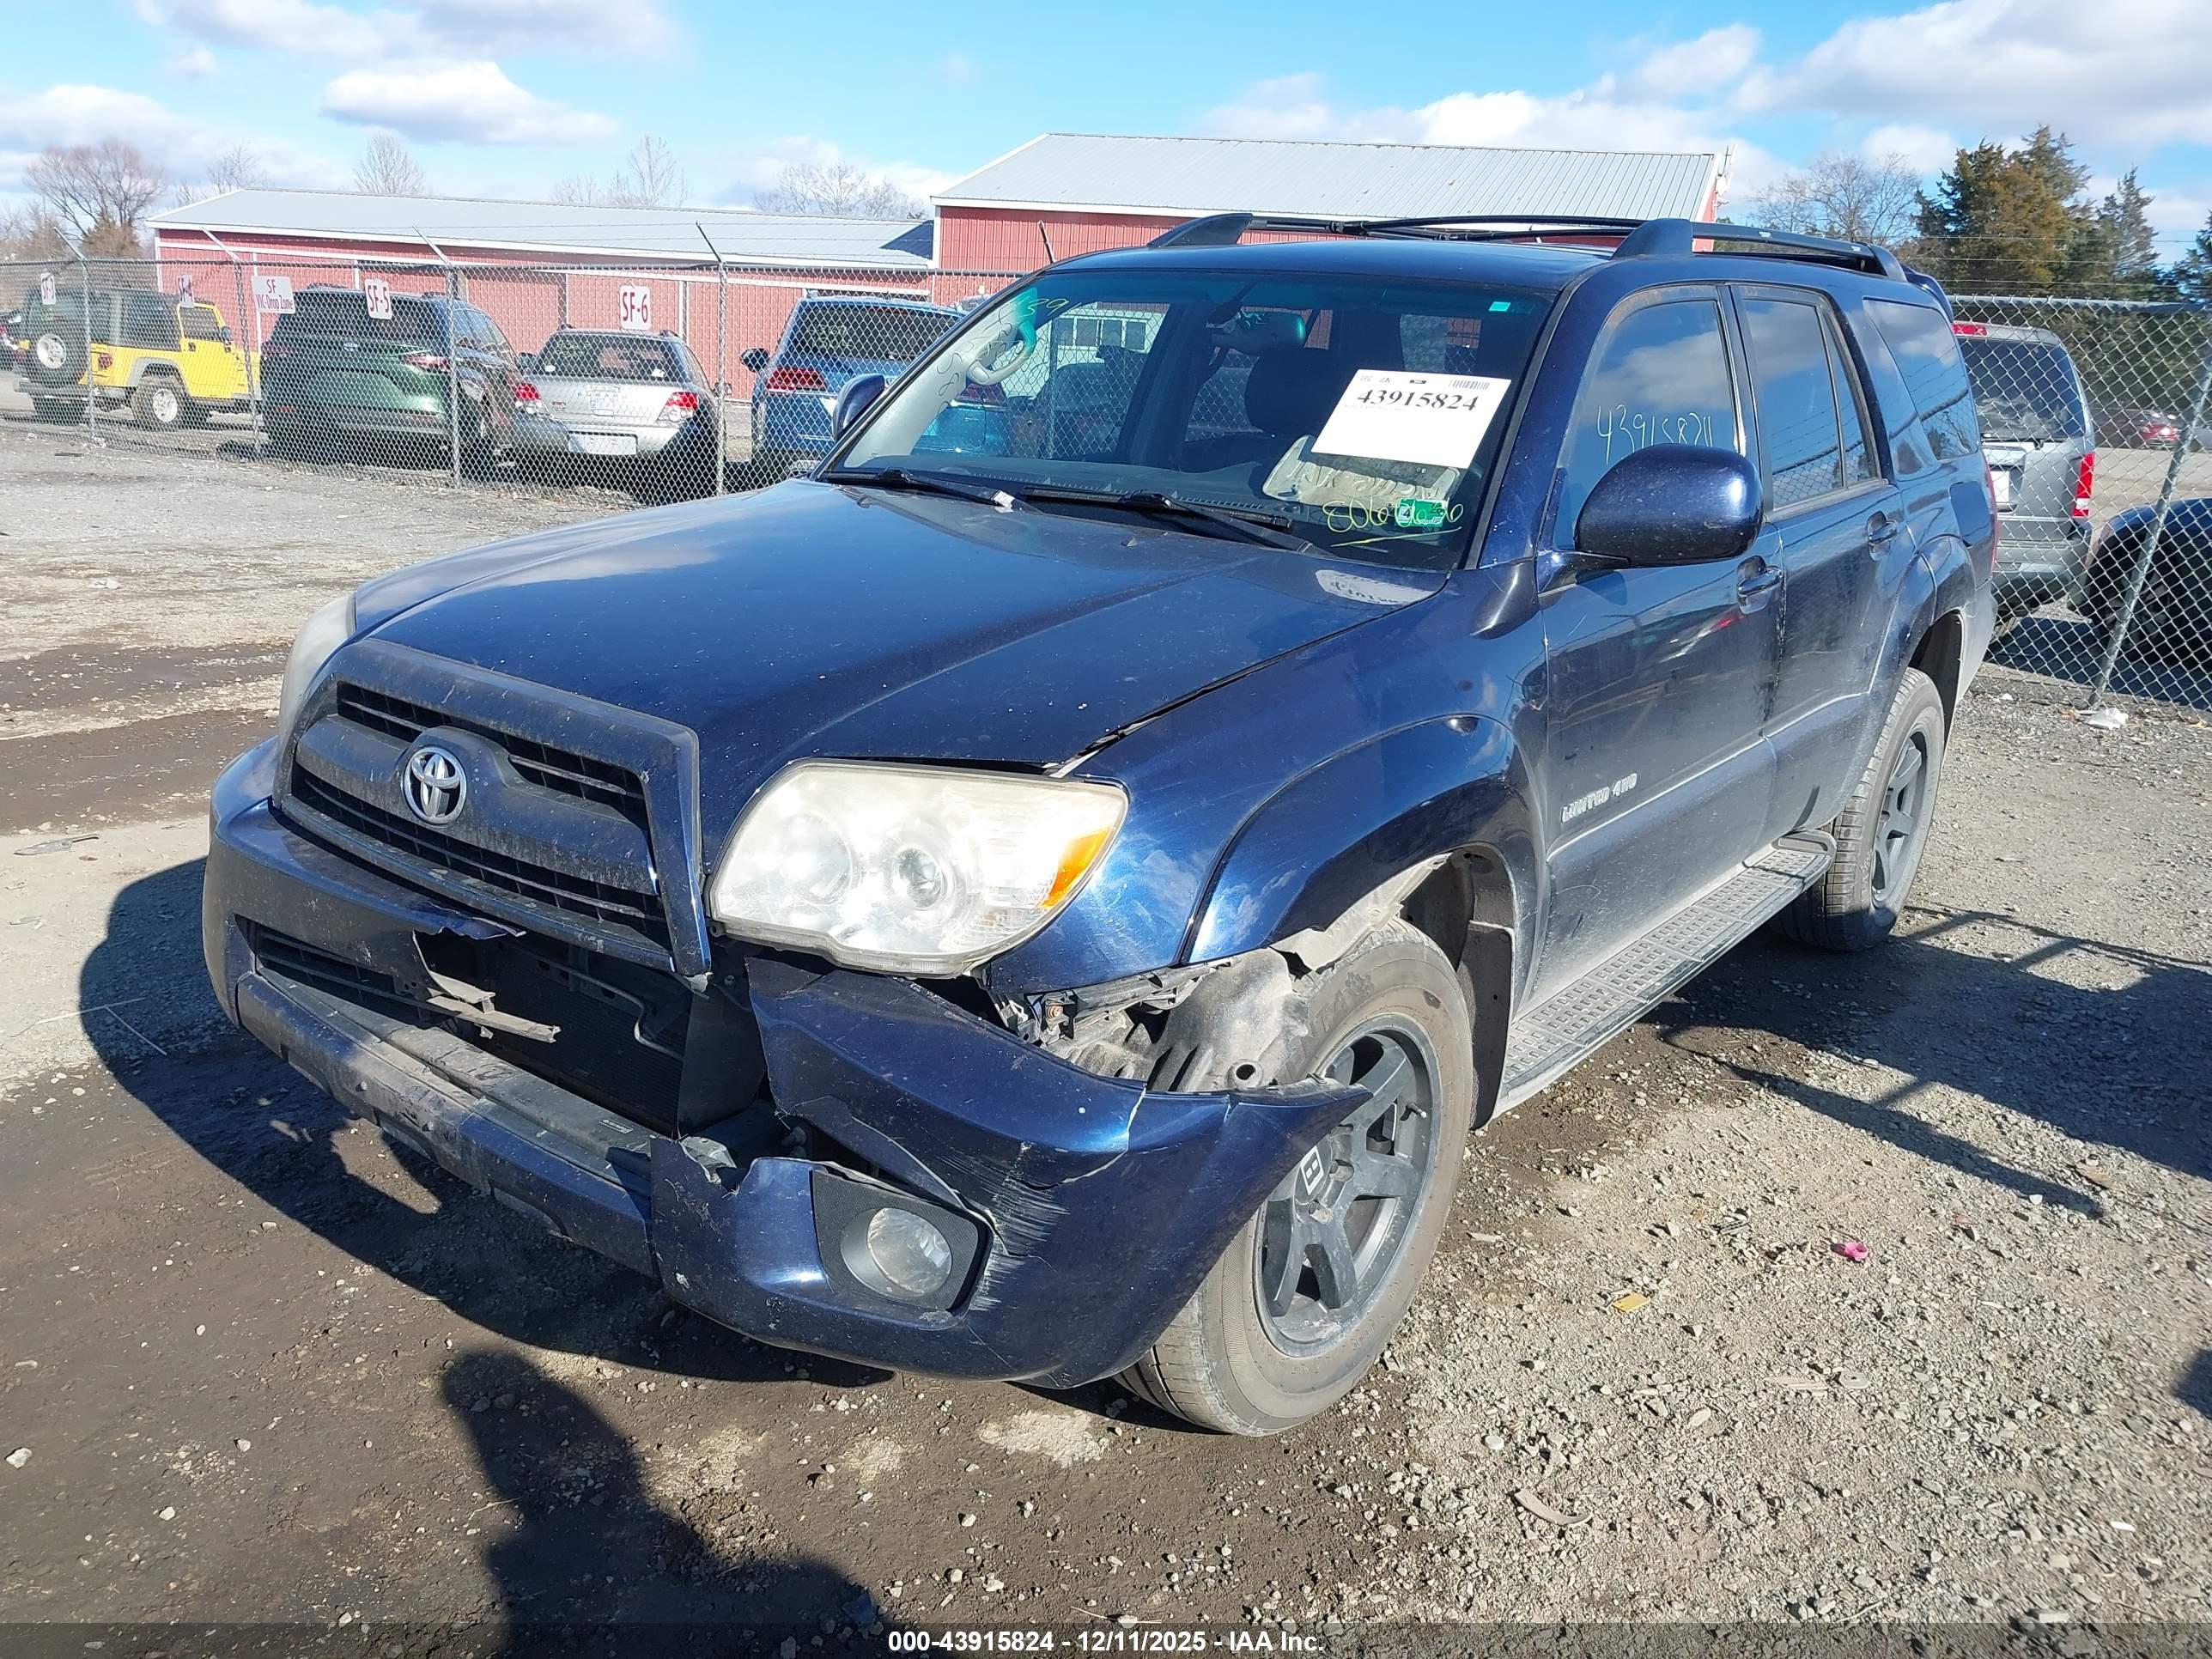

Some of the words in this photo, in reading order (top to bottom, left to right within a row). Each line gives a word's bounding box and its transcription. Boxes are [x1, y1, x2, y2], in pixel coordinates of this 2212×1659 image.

[266, 279, 276, 294] SF
[279, 295, 294, 310] Zone
[367, 285, 390, 313] SF-5
[622, 291, 648, 323] SF-6
[1357, 389, 1479, 410] 43915824
